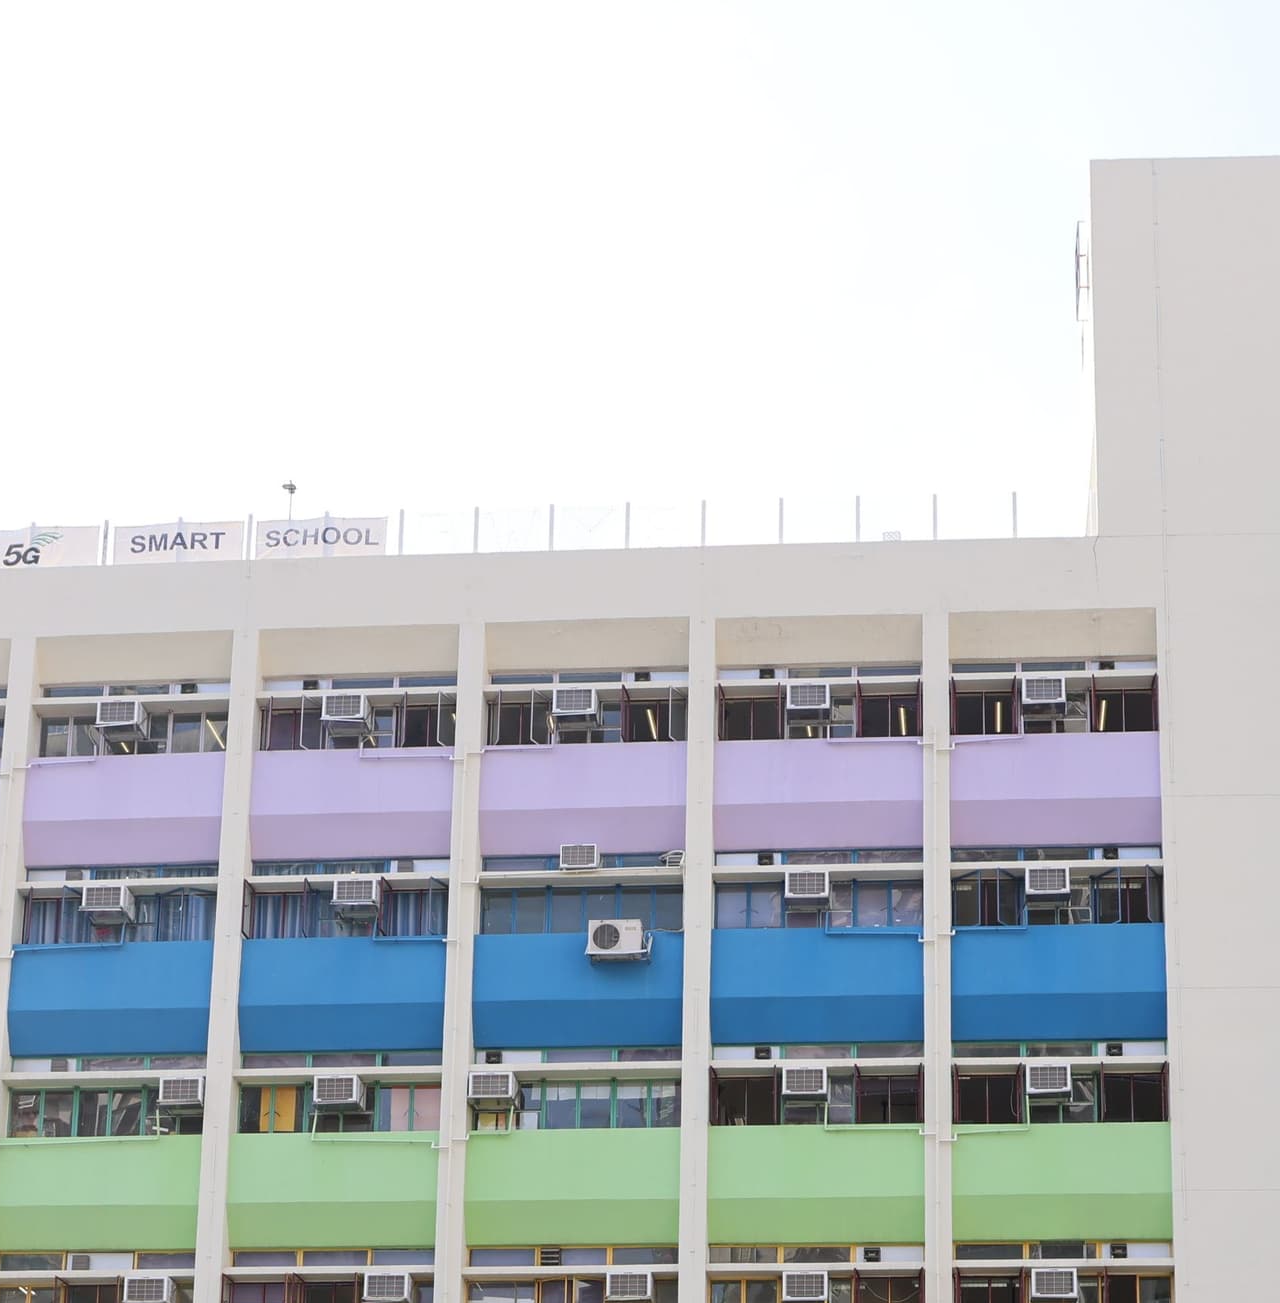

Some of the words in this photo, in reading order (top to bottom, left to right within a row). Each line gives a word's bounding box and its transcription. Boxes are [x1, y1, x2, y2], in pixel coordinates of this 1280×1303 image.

[2, 543, 42, 567] 5G
[130, 531, 226, 555] SMART
[264, 525, 380, 549] SCHOOL
